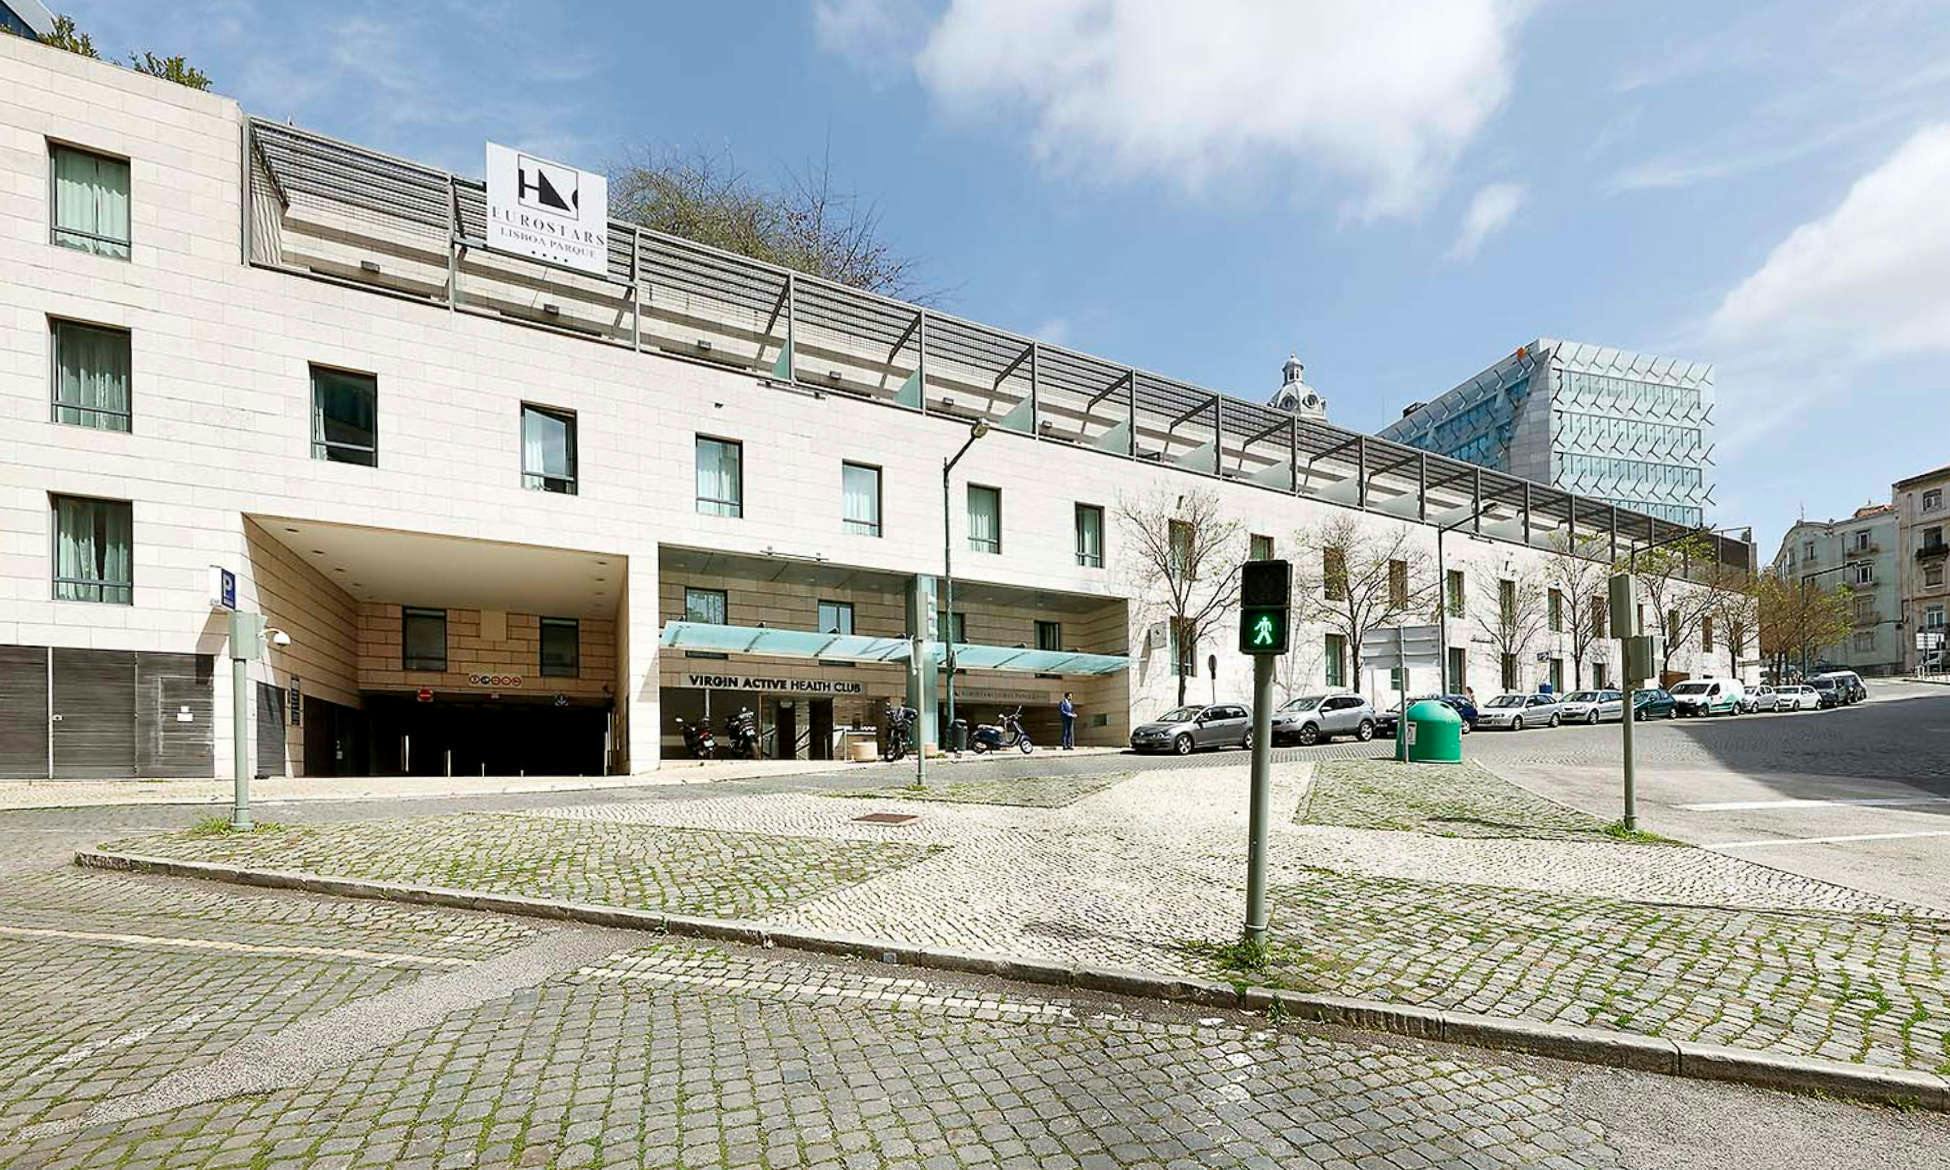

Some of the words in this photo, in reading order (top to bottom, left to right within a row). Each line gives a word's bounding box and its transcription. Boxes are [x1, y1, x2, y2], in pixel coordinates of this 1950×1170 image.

[492, 205, 605, 246] EUROSTARS
[500, 226, 547, 247] LISBOA
[550, 239, 595, 258] PARQUE
[223, 573, 233, 598] P
[689, 675, 739, 688] VIRGIN
[743, 678, 787, 690] ACTIVE
[790, 680, 831, 692] HEALTH
[833, 682, 861, 693] CLUB
